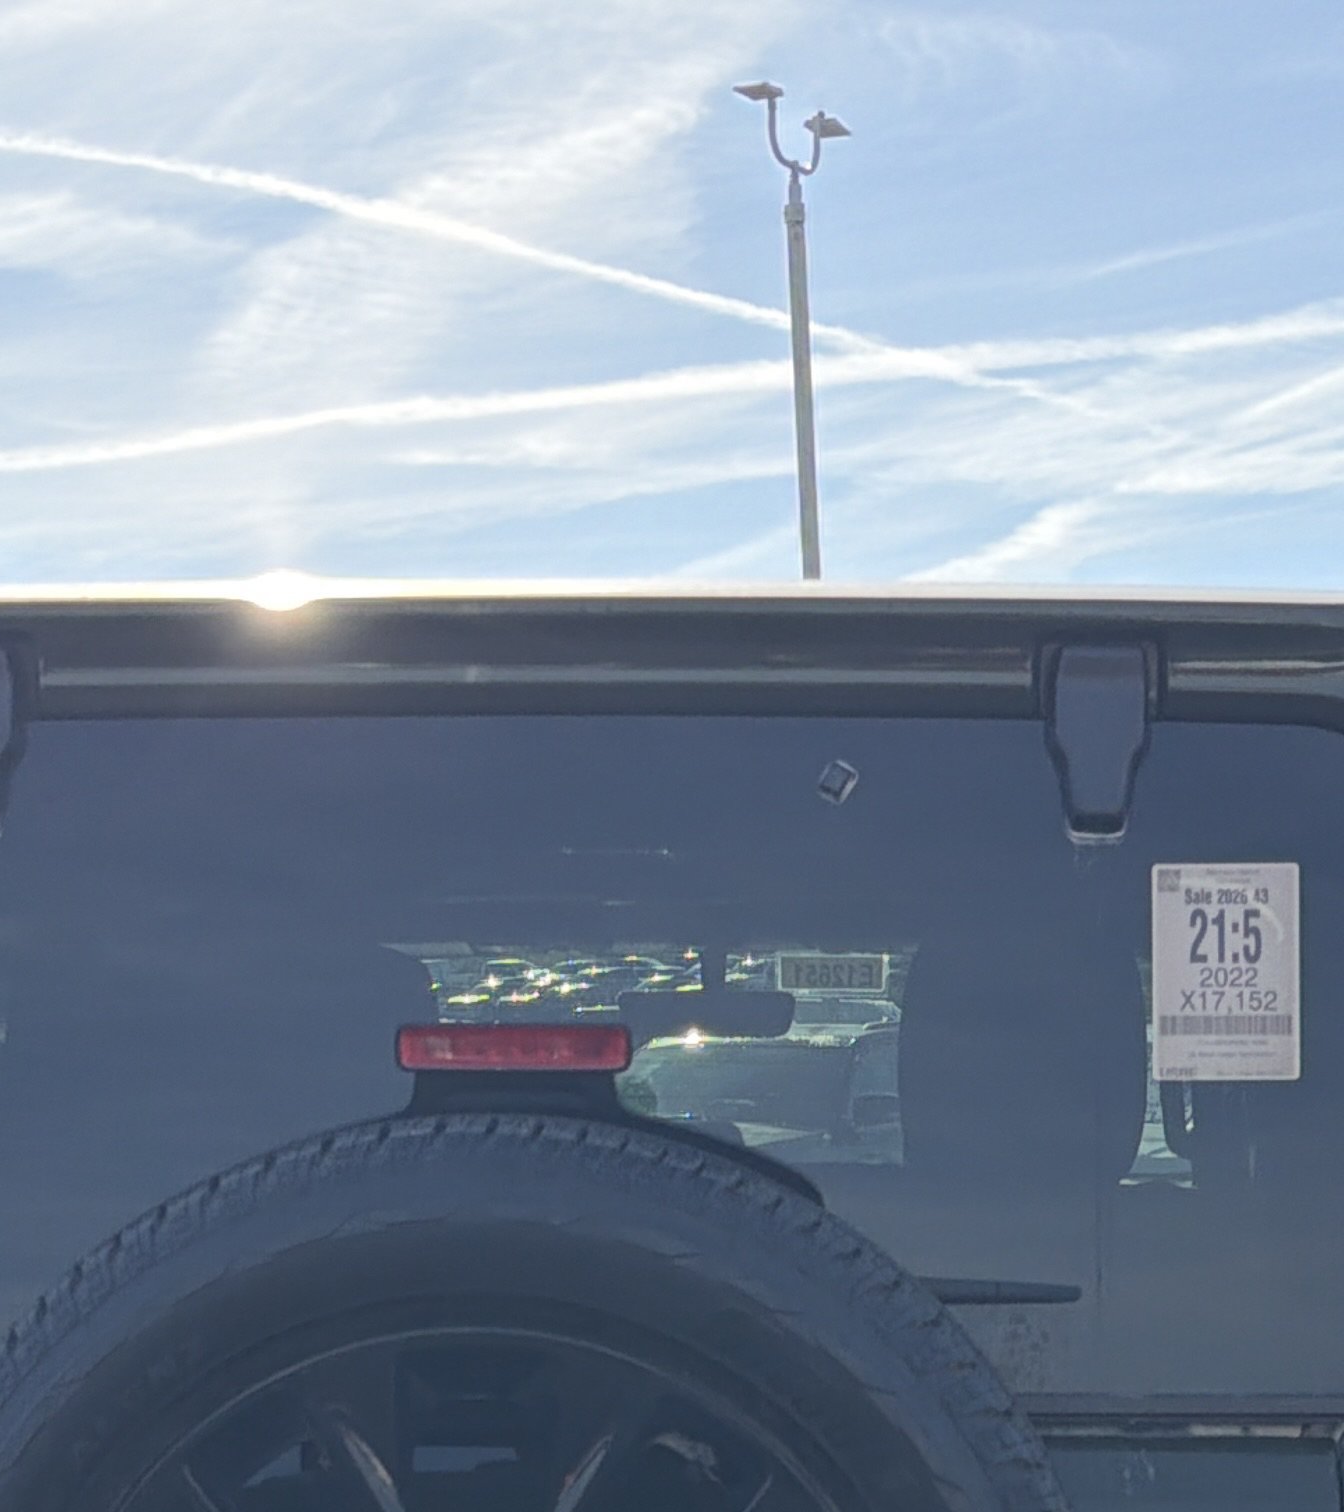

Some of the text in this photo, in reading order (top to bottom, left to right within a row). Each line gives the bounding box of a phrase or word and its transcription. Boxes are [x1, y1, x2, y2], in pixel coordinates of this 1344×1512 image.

[1184, 887, 1212, 905] Sale
[1253, 887, 1269, 905] 43
[1189, 908, 1262, 964] 21:5
[1199, 967, 1258, 988] 2022
[1180, 990, 1278, 1013] X17,152
